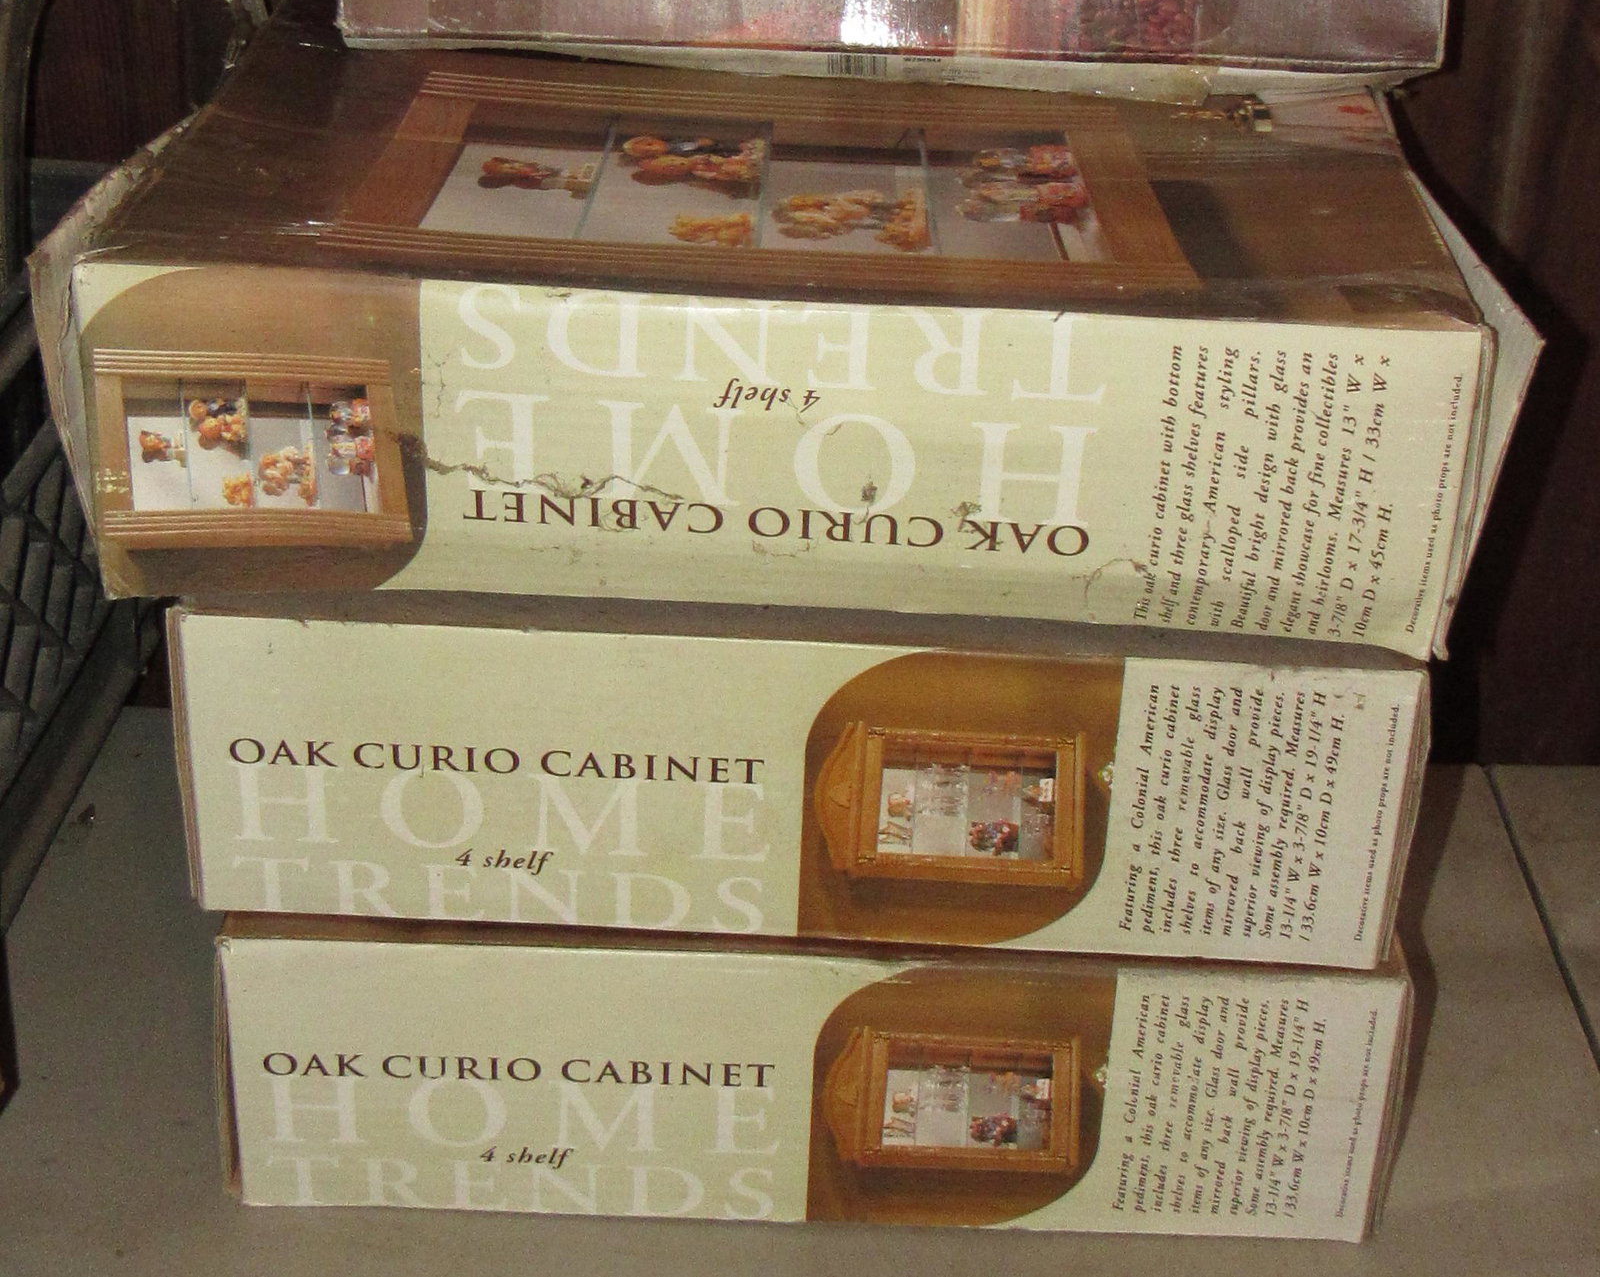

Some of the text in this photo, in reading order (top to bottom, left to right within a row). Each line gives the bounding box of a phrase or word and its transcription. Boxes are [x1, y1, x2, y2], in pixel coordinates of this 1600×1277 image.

[456, 284, 1105, 403] TRENDS
[1354, 354, 1364, 366] x
[1380, 356, 1390, 366] x
[713, 378, 822, 410] 4 shelf
[1162, 346, 1182, 407] bottom
[1346, 374, 1362, 393] W
[1372, 373, 1387, 392] W
[454, 390, 1098, 525] HOME
[1160, 416, 1176, 452] with
[1365, 404, 1384, 448] 33cm
[1152, 460, 1170, 519] cabinet
[1158, 346, 1208, 623] shelf and three glass shelves features
[1186, 347, 1240, 625] contemporary American styling
[1209, 352, 1261, 626] with scalloped side pillars.
[1231, 350, 1288, 628] Beautiful bright design with glass
[1255, 352, 1312, 630] door and mirrored back provides an
[1280, 353, 1338, 632] elegant showcase for fine collectibles
[1327, 448, 1352, 521] Measures
[1358, 468, 1374, 484] H
[463, 489, 1090, 557] OAK CURIO CABINET
[1148, 527, 1163, 566] curio
[1311, 533, 1338, 606] heirlooms.
[1340, 578, 1354, 590] D
[1348, 562, 1357, 571] x
[1352, 504, 1393, 637] 10cm D x 45cm H.
[1134, 598, 1150, 619] This
[1307, 611, 1320, 634] and
[1330, 715, 1344, 731] H.
[229, 737, 766, 785] OAK CURIO CABINET
[1287, 867, 1300, 882] W
[1294, 856, 1303, 864] x
[1300, 787, 1312, 800] D
[1306, 774, 1315, 783] x
[1313, 691, 1326, 706] H
[1324, 738, 1342, 774] 49cm
[1326, 780, 1335, 788] x
[232, 766, 770, 862] HOME
[1118, 685, 1159, 931] Featuring a Colonial American
[1141, 684, 1180, 934] pediment, this oak curio cabinet
[1160, 686, 1202, 933] includes three removable glass
[1179, 687, 1226, 934] shelves to accommodate display
[1200, 687, 1243, 935] items of any size. Glass door and
[1221, 689, 1264, 936] mirrored back wall provide
[1243, 692, 1284, 938] superior viewing of display pieces.
[1258, 692, 1305, 938] Some assembly required. Measures
[1314, 811, 1330, 846] 10cm
[1319, 792, 1332, 805] D
[454, 849, 555, 875] 4 shelf
[1308, 862, 1322, 877] W
[1316, 851, 1324, 860] x
[232, 855, 766, 935] TRENDS
[1301, 884, 1319, 932] 33.6cm
[262, 1052, 776, 1088] OAK CURIO CABINET
[267, 1077, 780, 1156] HOME
[1230, 1000, 1269, 1215] superior viewing of display pieces.
[1246, 999, 1289, 1216] Some assembly required. Measures
[265, 1156, 775, 1222] TRENDS
[479, 1146, 575, 1170] 4 shelf
